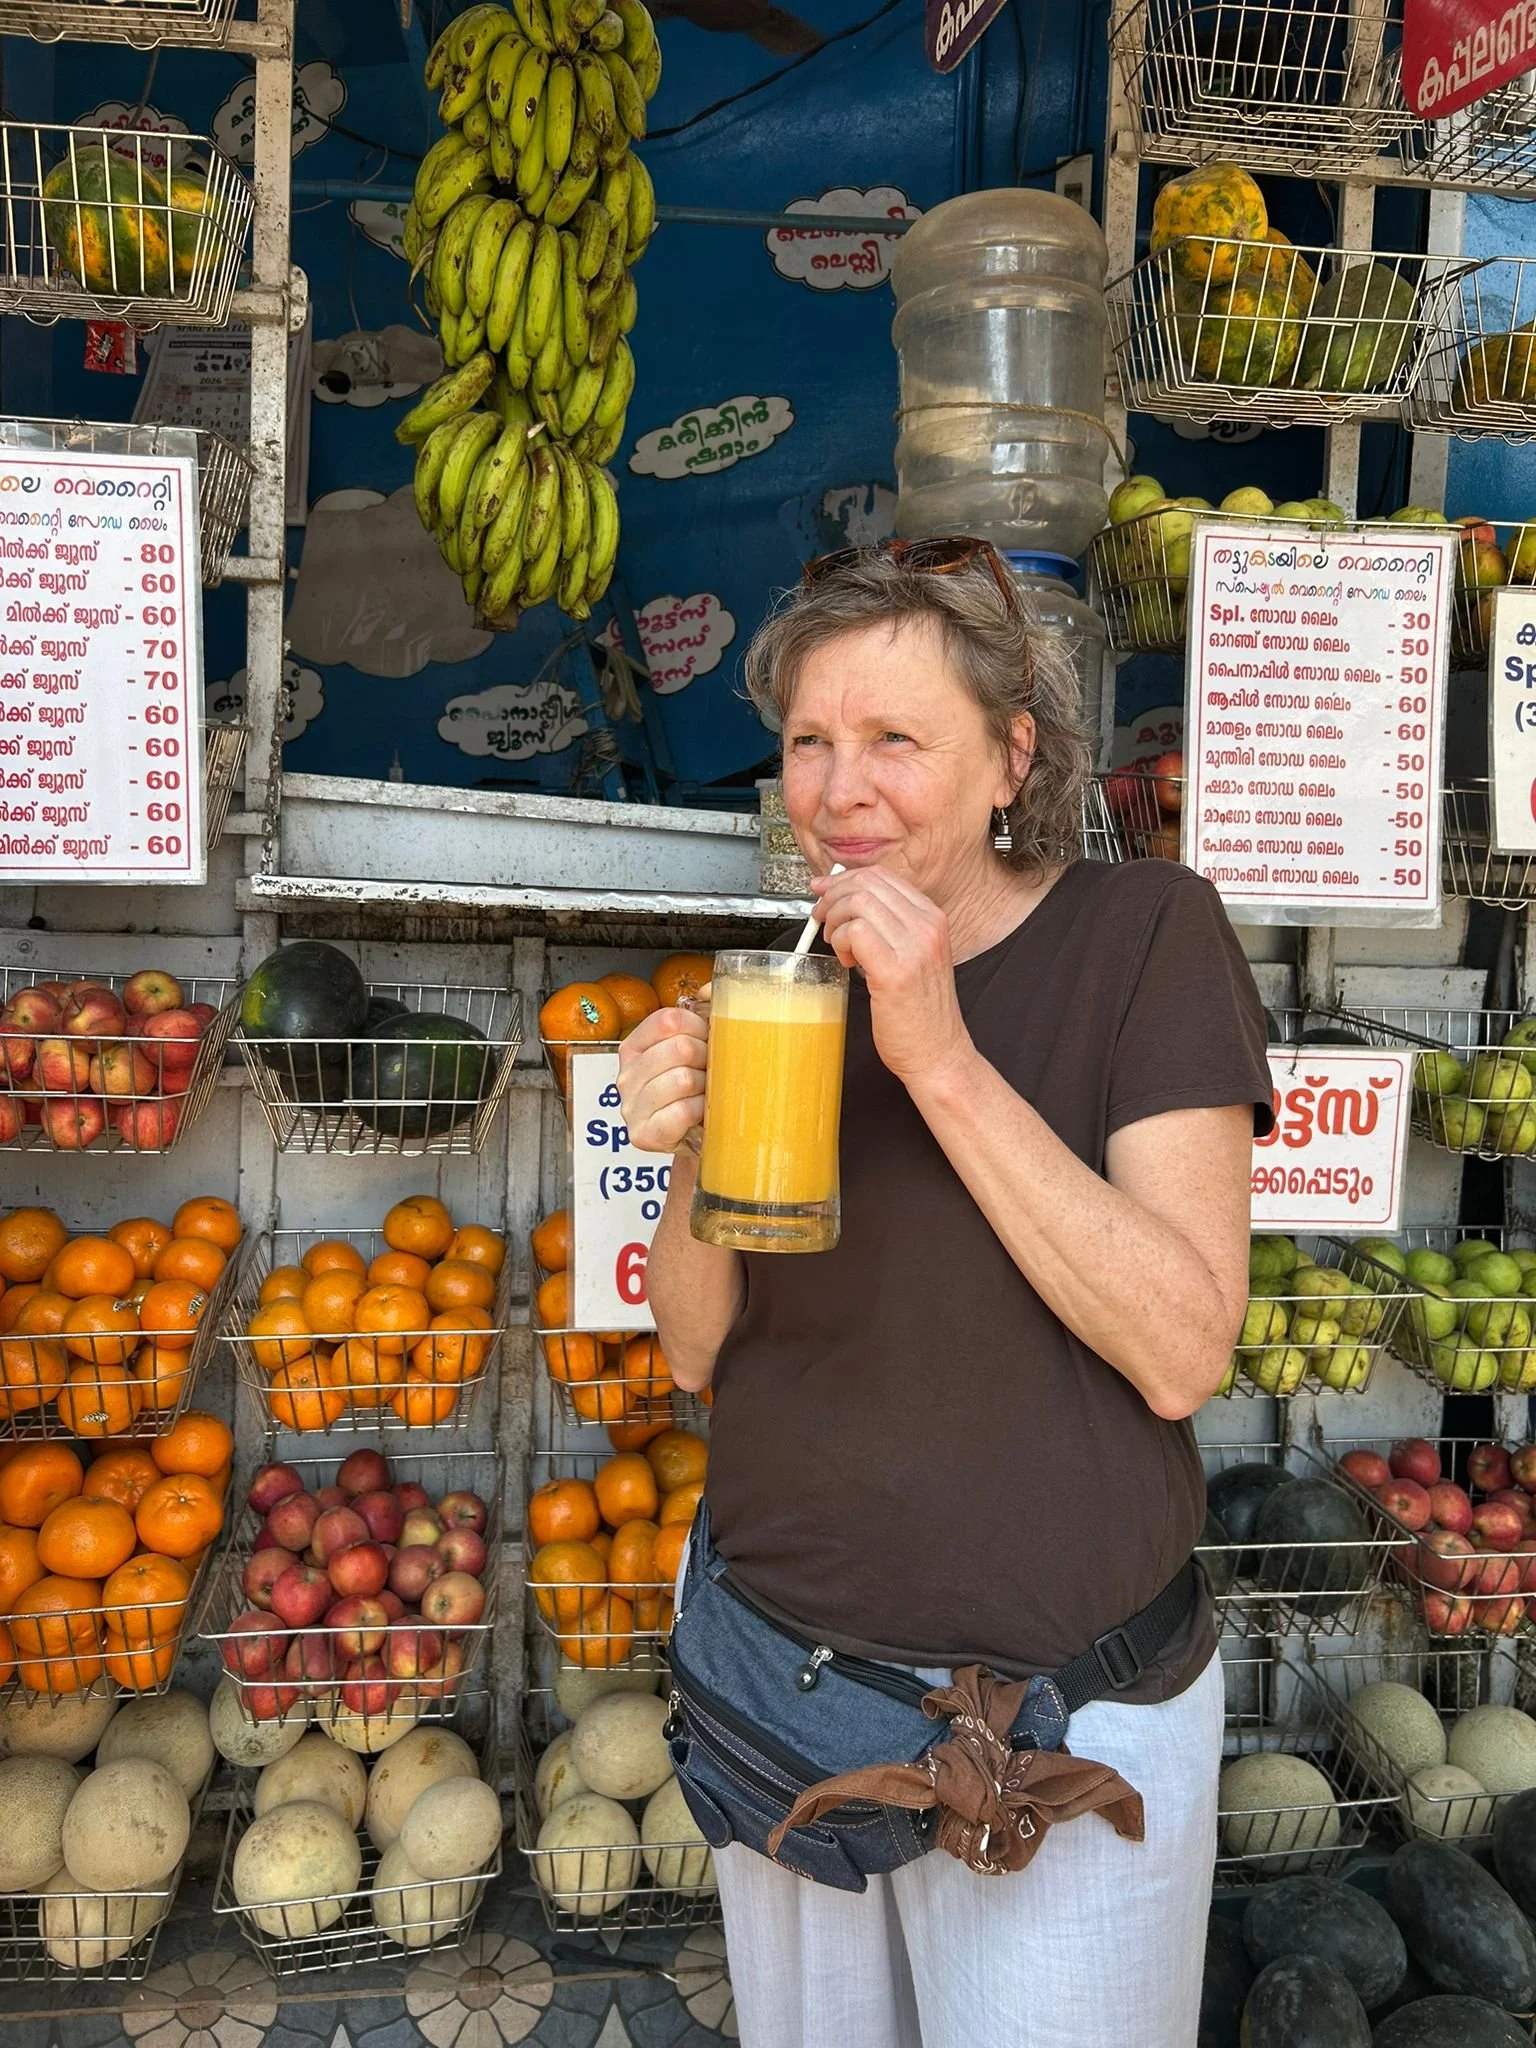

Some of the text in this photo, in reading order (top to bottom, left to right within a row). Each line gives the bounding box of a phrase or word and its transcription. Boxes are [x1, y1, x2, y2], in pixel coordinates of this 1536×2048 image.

[199, 377, 222, 385] 2026
[54, 475, 171, 511] വെറൈറ്റി
[68, 514, 122, 529] സോഡ
[129, 517, 167, 531] ലൈം
[141, 544, 175, 564] 80
[1338, 552, 1433, 584] വെറൈറ്റി
[141, 574, 175, 594] 60
[1347, 587, 1390, 600] സോഡ
[1395, 589, 1426, 601] ലൈം
[6, 600, 70, 623] മിൽക്ക്
[142, 606, 176, 627] 60
[1210, 604, 1244, 625] Spl.
[1250, 609, 1296, 624] സോഡ
[1301, 611, 1338, 626] ലൈം
[1402, 612, 1430, 630] 30
[143, 640, 177, 659] 70
[1263, 635, 1308, 651] സോഡ
[1313, 637, 1350, 652] ലൈം
[1401, 639, 1429, 656] 50
[144, 671, 178, 690] 70
[1294, 666, 1339, 681] സോഡ
[1344, 668, 1381, 683] ലൈം
[1400, 667, 1427, 684] 50
[1207, 688, 1259, 711] ആപ്പിൾ
[1264, 694, 1309, 709] സോഡ
[1315, 696, 1351, 711] ലൈം
[1399, 696, 1426, 713] 60
[145, 705, 179, 725] 60
[1206, 721, 1251, 740] മാതളം
[1256, 723, 1302, 738] സോഡ
[1306, 725, 1343, 739] ലൈം
[1398, 724, 1425, 741] 60
[146, 738, 179, 757] 60
[1259, 752, 1304, 767] സോഡ
[1309, 754, 1346, 768] ലൈം
[1397, 754, 1424, 771] 50
[146, 771, 180, 790] 60
[1205, 780, 1243, 794] ഷമാം
[1248, 781, 1294, 796] സോഡ
[1299, 783, 1335, 797] ലൈം
[1396, 783, 1423, 800] 50
[147, 803, 181, 822] 60
[1255, 811, 1301, 825] സോഡ
[1306, 812, 1342, 827] ലൈം
[148, 836, 181, 856] 60
[1203, 838, 1252, 853] പേരക്ക
[1257, 840, 1302, 854] സോഡ
[1307, 841, 1344, 855] ലൈം
[1394, 840, 1422, 857] 50
[1272, 869, 1317, 883] സോഡ
[1322, 871, 1359, 885] ലൈം
[1394, 869, 1421, 886] 50
